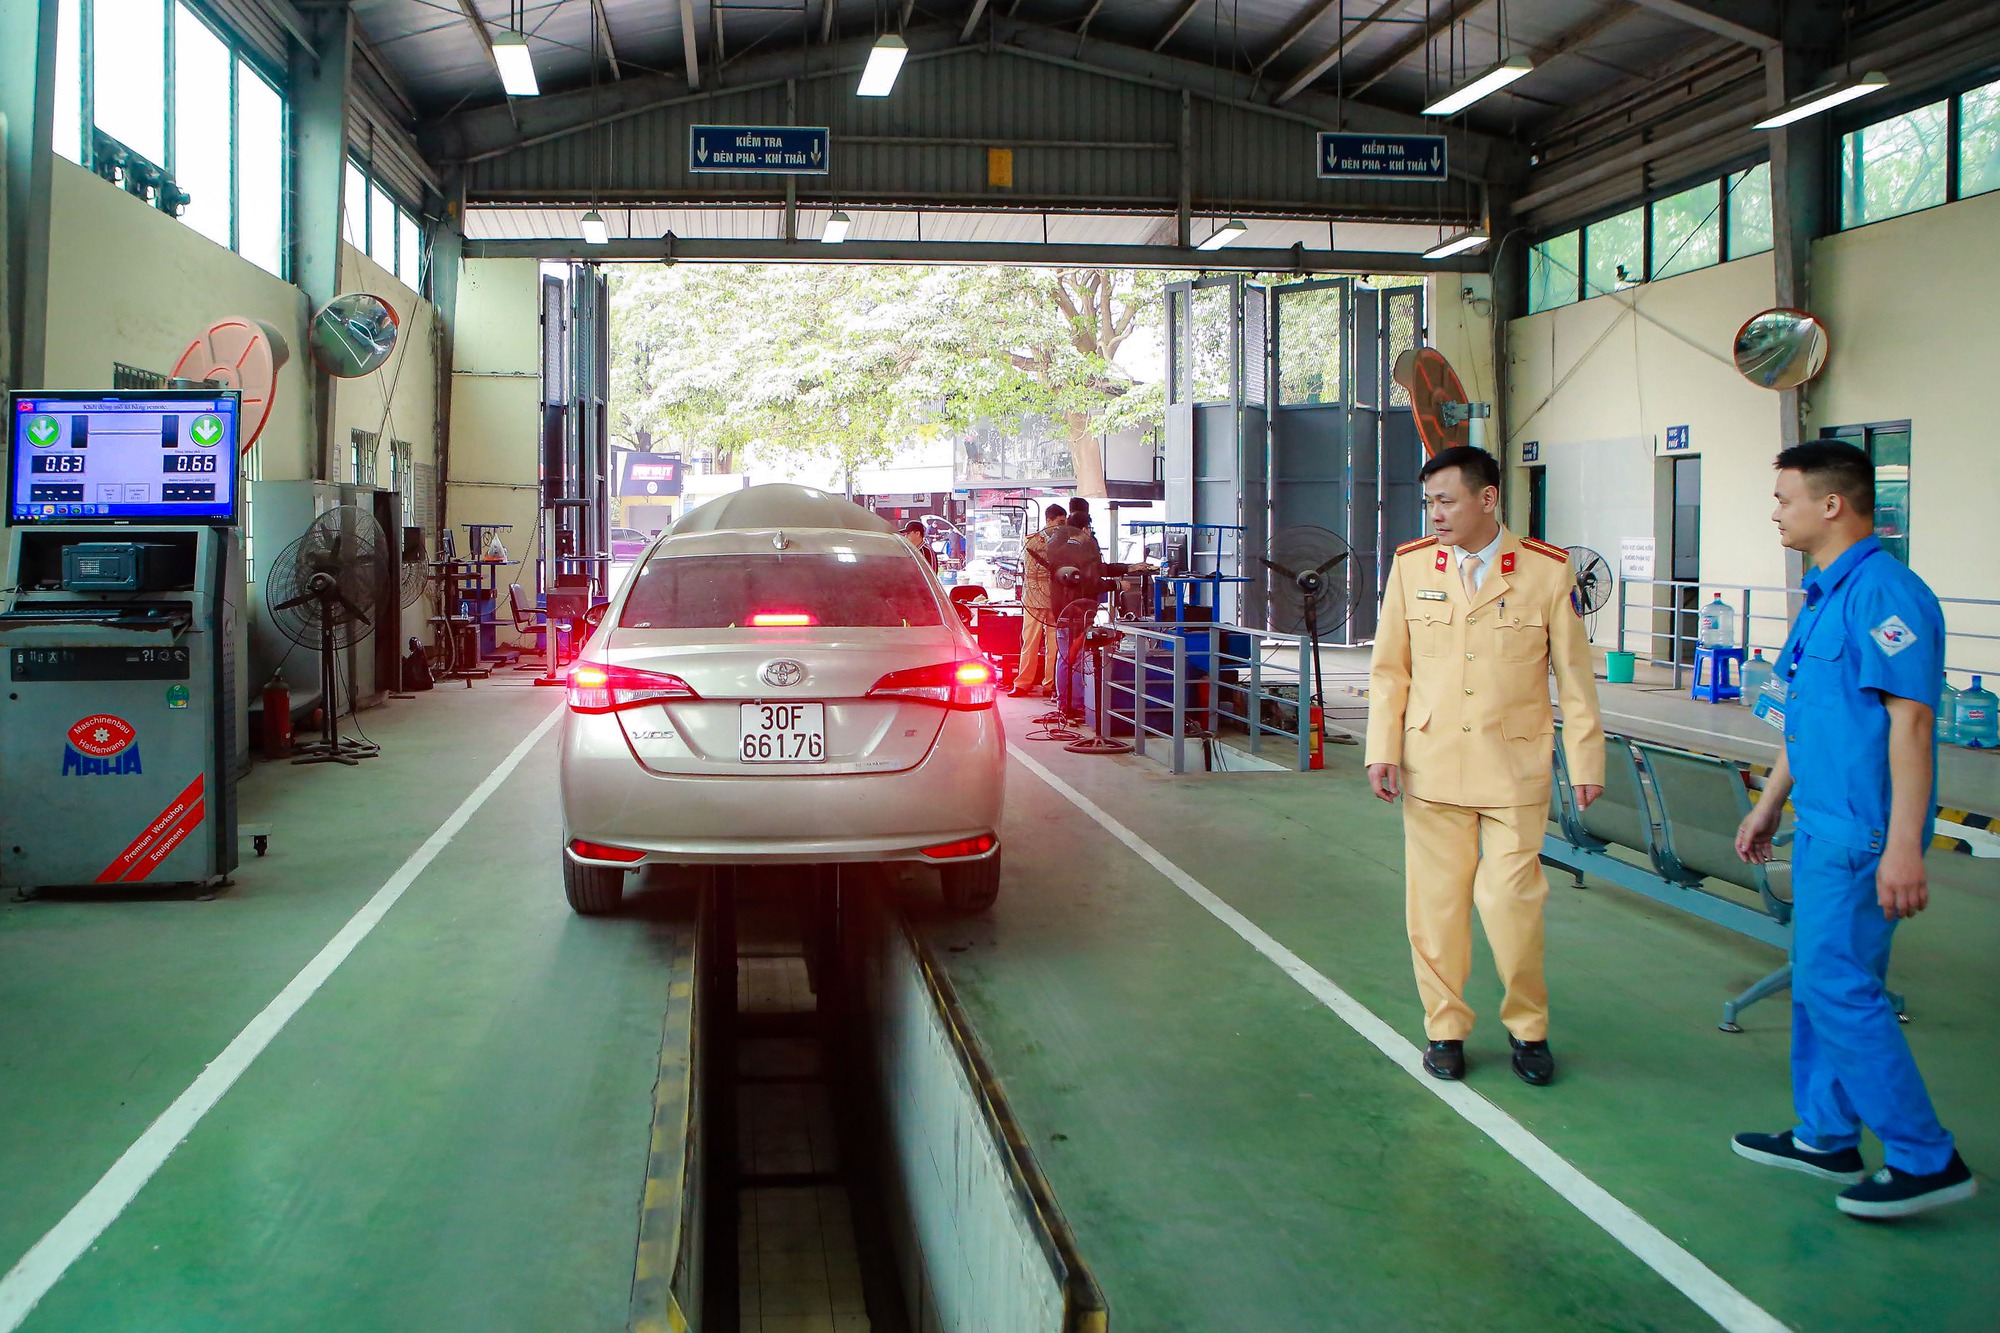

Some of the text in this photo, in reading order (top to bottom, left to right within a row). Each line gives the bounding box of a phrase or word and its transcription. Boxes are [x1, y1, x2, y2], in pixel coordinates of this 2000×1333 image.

[736, 132, 783, 148] KIỂM TRA
[1362, 140, 1405, 155] KIỂM TRA
[713, 151, 733, 163] ĐÈN
[736, 153, 756, 164] PHA
[765, 151, 782, 164] KHÍ
[784, 151, 806, 165] THẢI
[1341, 157, 1360, 170] ĐÈN
[1362, 160, 1381, 170] PHA
[1389, 158, 1405, 171] KHÍ
[1407, 158, 1427, 172] THẢI
[45, 456, 83, 472] 0.63
[177, 456, 214, 472] 0.66
[73, 716, 131, 735] Maschinenbau
[760, 705, 804, 731] 30F
[78, 738, 126, 754] Haldenwang
[743, 733, 822, 759] 661.76
[62, 740, 143, 776] MAHA
[124, 803, 185, 863] Premium Workshop
[150, 827, 185, 862] Equipment
